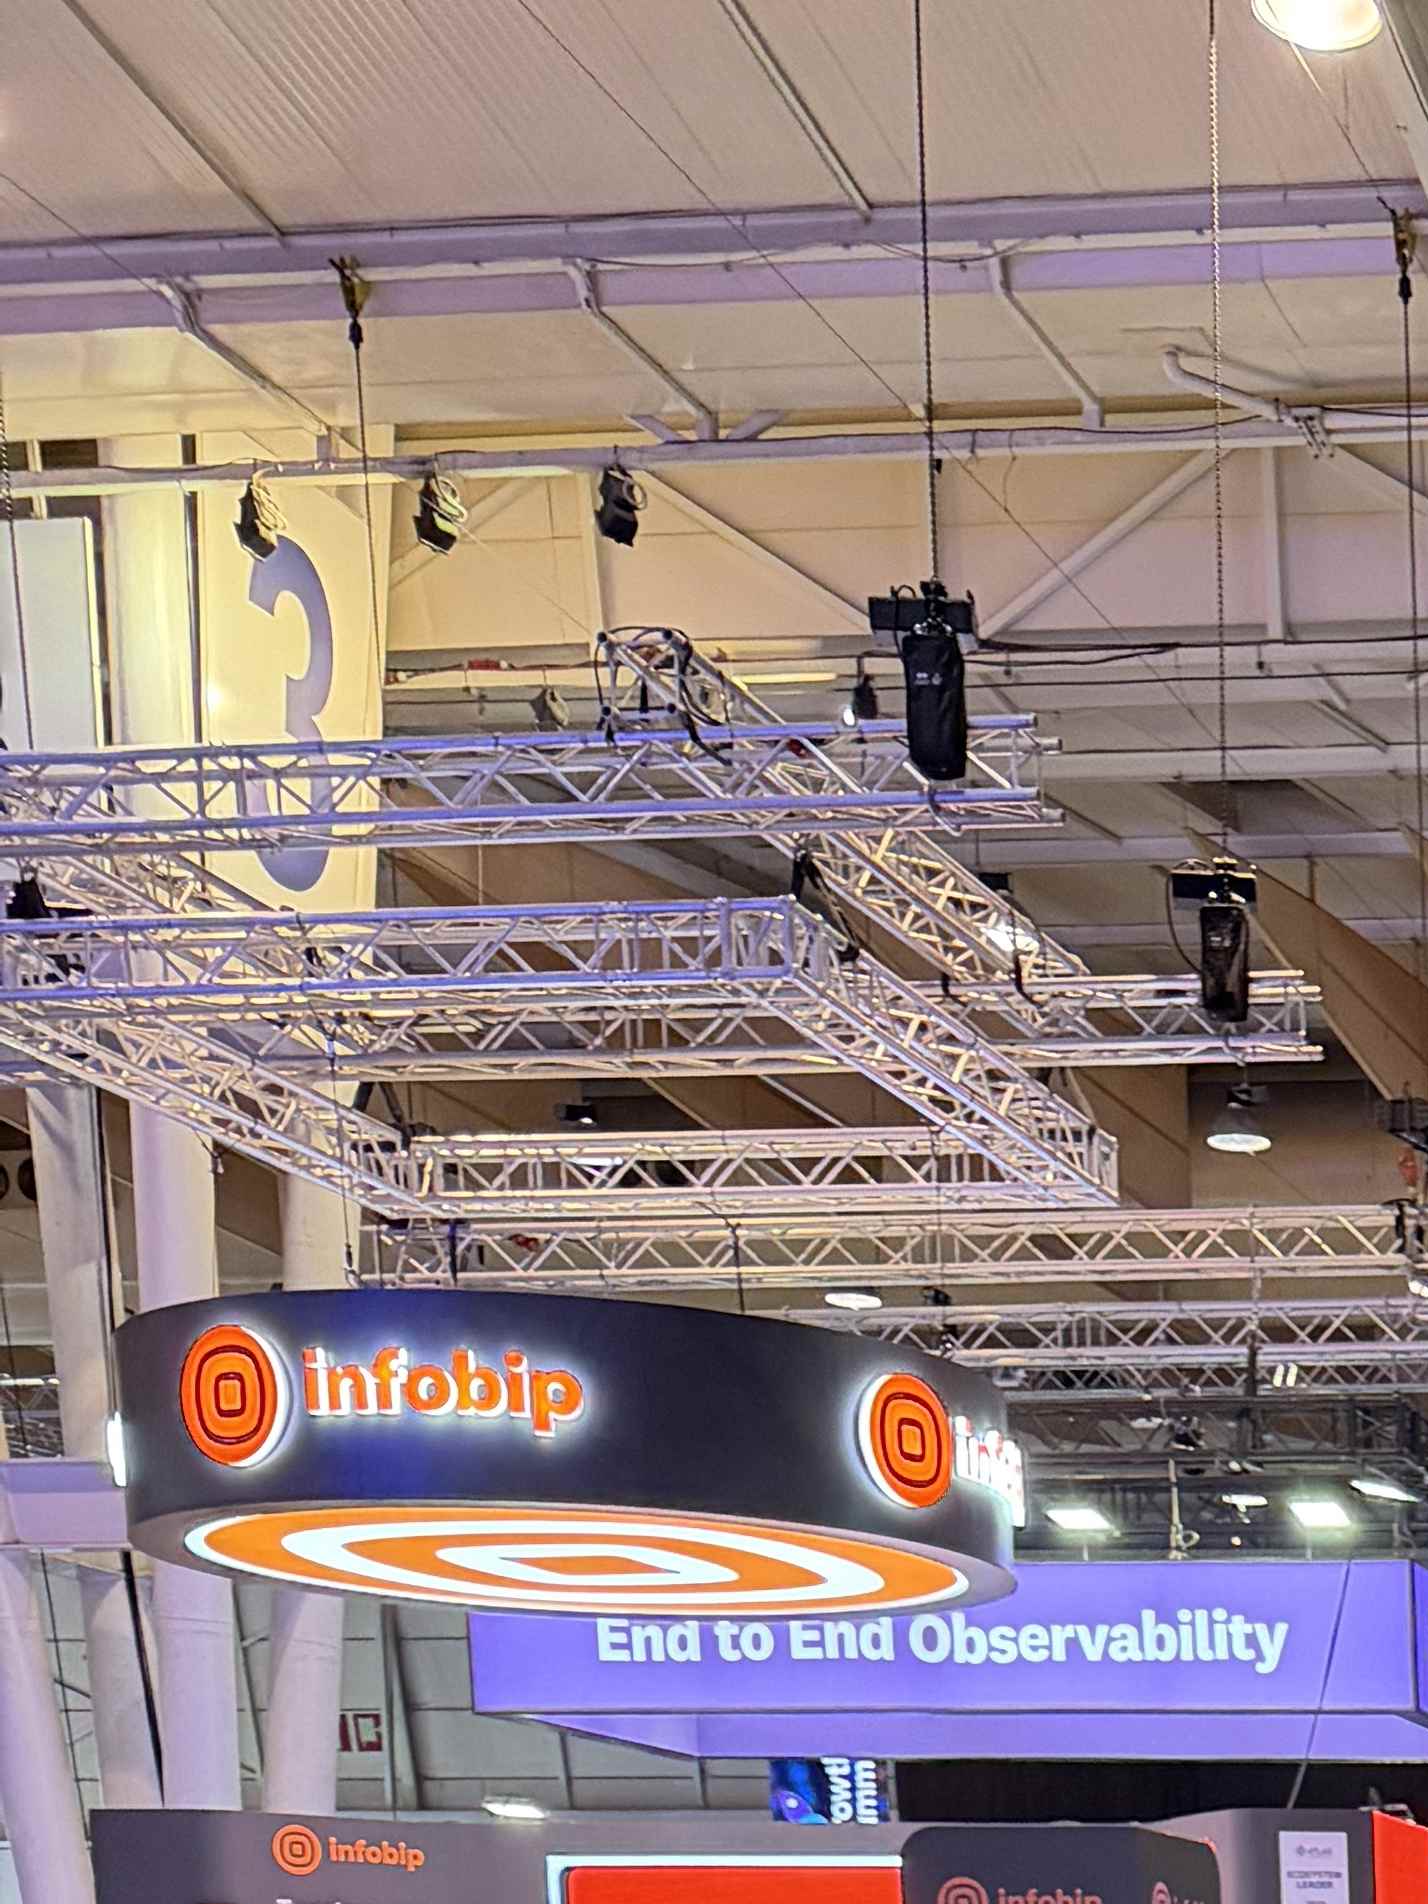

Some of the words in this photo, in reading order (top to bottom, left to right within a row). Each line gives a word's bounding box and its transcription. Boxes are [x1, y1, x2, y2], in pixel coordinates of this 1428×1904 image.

[302, 1345, 586, 1438] infobip
[596, 1617, 702, 1662] End
[713, 1619, 775, 1661] to
[788, 1617, 896, 1661] End
[908, 1607, 1290, 1675] Observability
[328, 1836, 426, 1872] infobip
